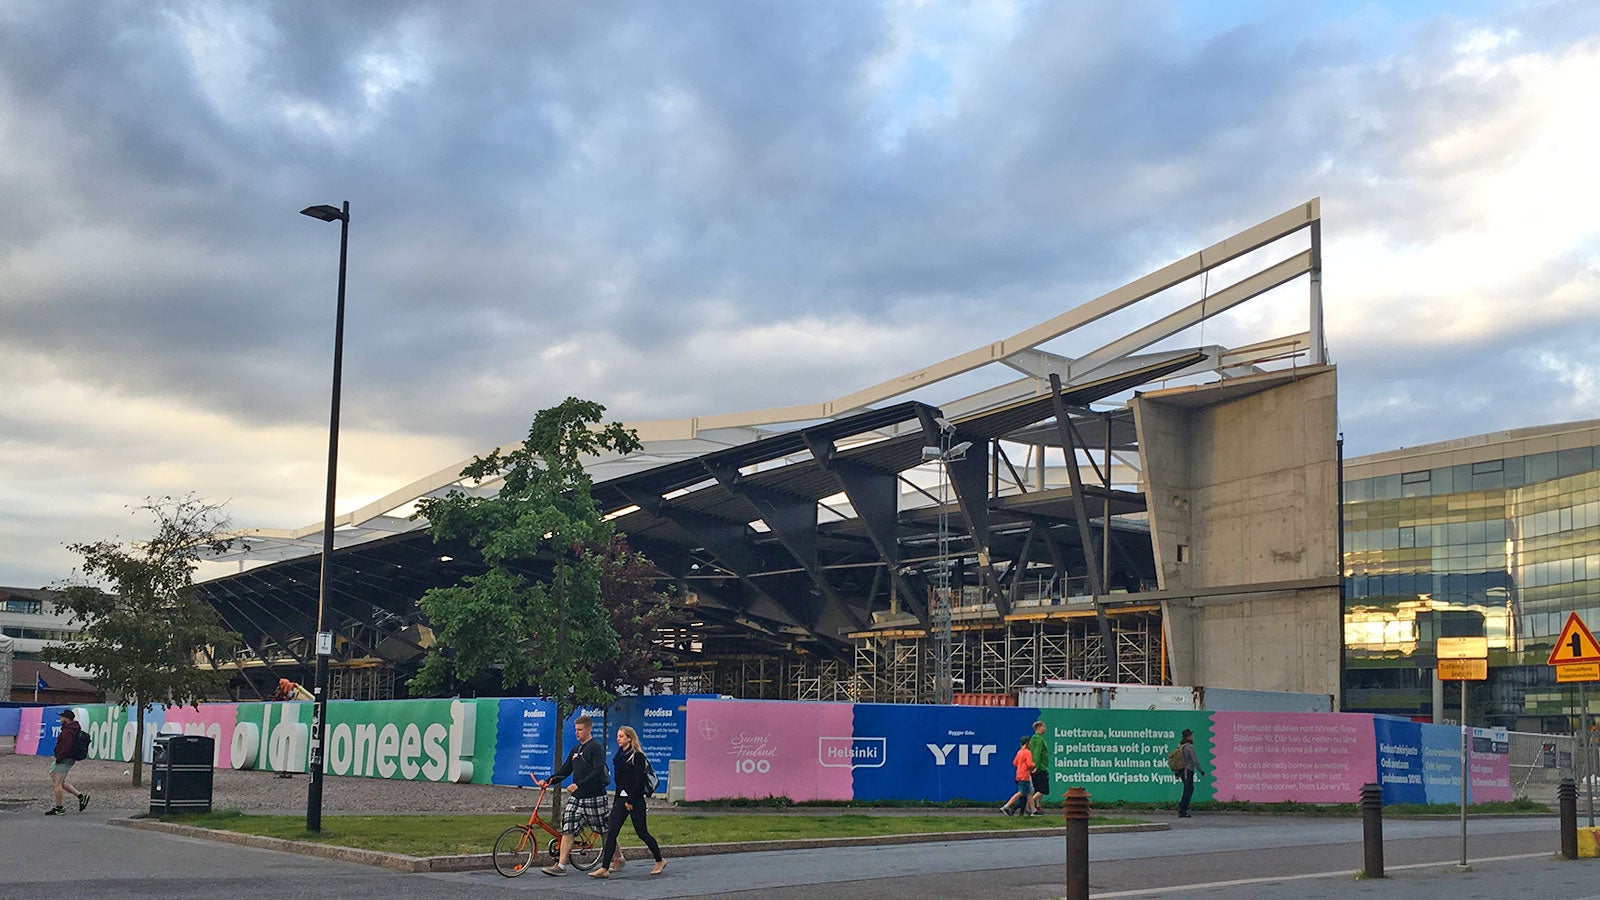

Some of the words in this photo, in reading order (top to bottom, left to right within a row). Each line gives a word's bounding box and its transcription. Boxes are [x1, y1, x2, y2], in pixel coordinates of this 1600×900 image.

[581, 708, 605, 717] #oodiss
[643, 707, 673, 717] #oodissa
[731, 732, 770, 745] Suomi
[1054, 727, 1107, 740] Luettavaa,
[1108, 728, 1175, 740] kuunneltavaa
[828, 746, 877, 758] Helsinki
[926, 743, 997, 766] YIT
[1054, 742, 1064, 755] ja
[1066, 743, 1118, 755] pelattavaa
[1120, 744, 1139, 754] voit
[1140, 743, 1151, 755] jo
[1152, 744, 1169, 755] nyt
[735, 759, 771, 774] 100
[1054, 757, 1089, 767] lainata
[1090, 757, 1112, 768] ihan
[1114, 758, 1151, 768] kulman
[1234, 761, 1247, 769] You
[1055, 772, 1107, 783] Postitalon
[1109, 773, 1150, 784] Kirjasto
[1281, 772, 1290, 780] to
[1299, 783, 1315, 791] from
